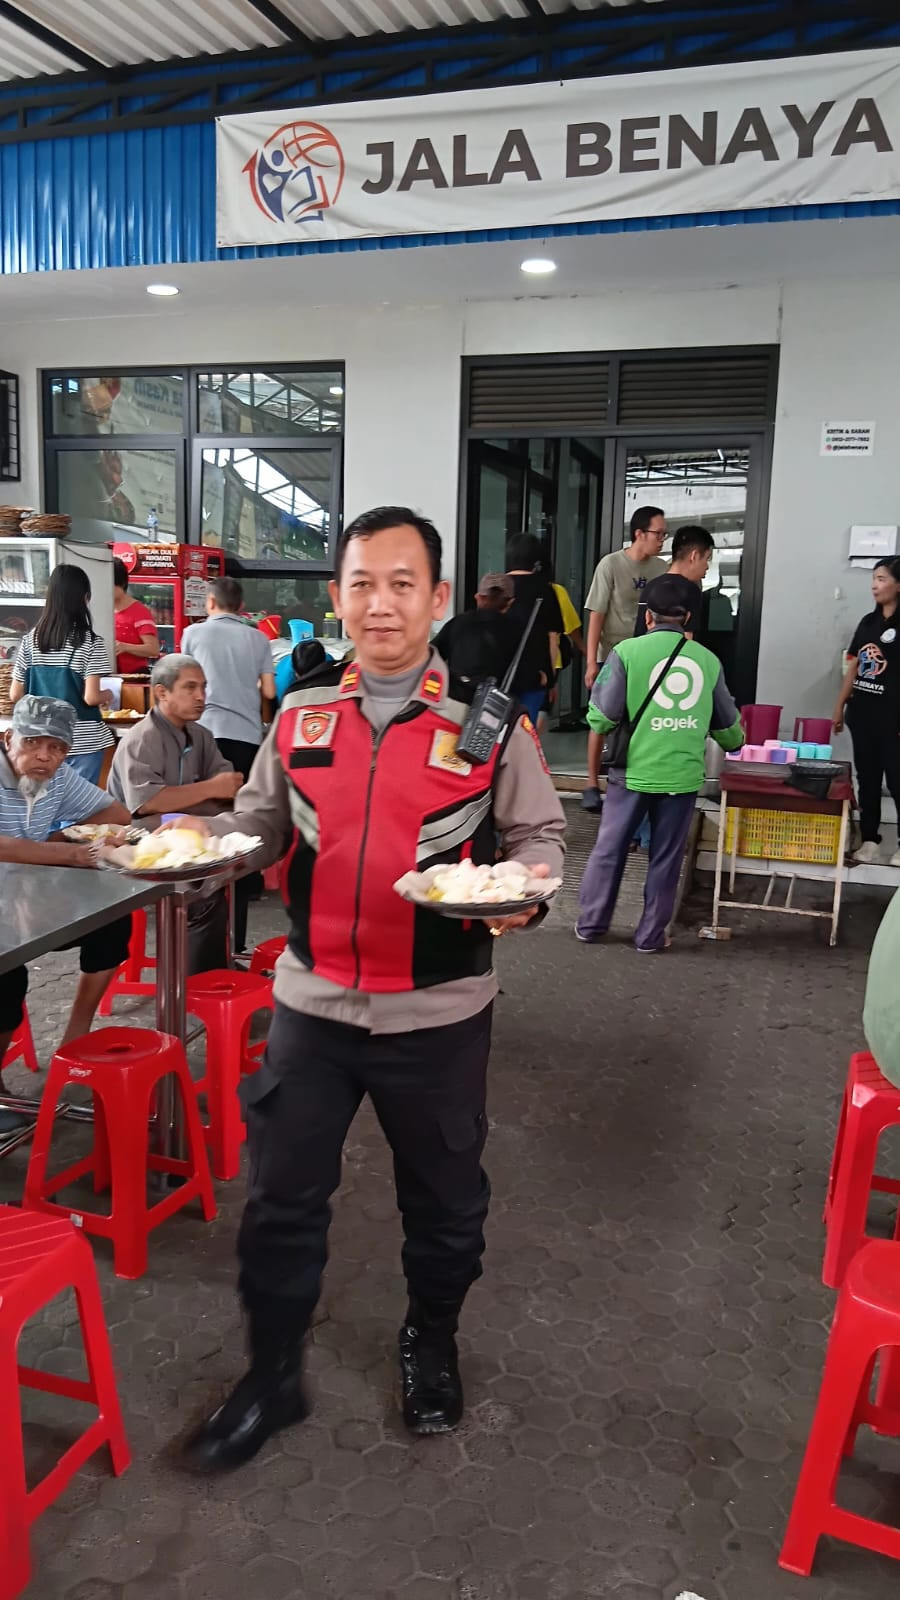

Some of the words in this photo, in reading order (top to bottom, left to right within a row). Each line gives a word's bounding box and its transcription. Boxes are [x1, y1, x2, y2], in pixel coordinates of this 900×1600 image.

[361, 129, 541, 195] JALA
[565, 97, 894, 179] BENAYA
[650, 715, 698, 732] gojek
